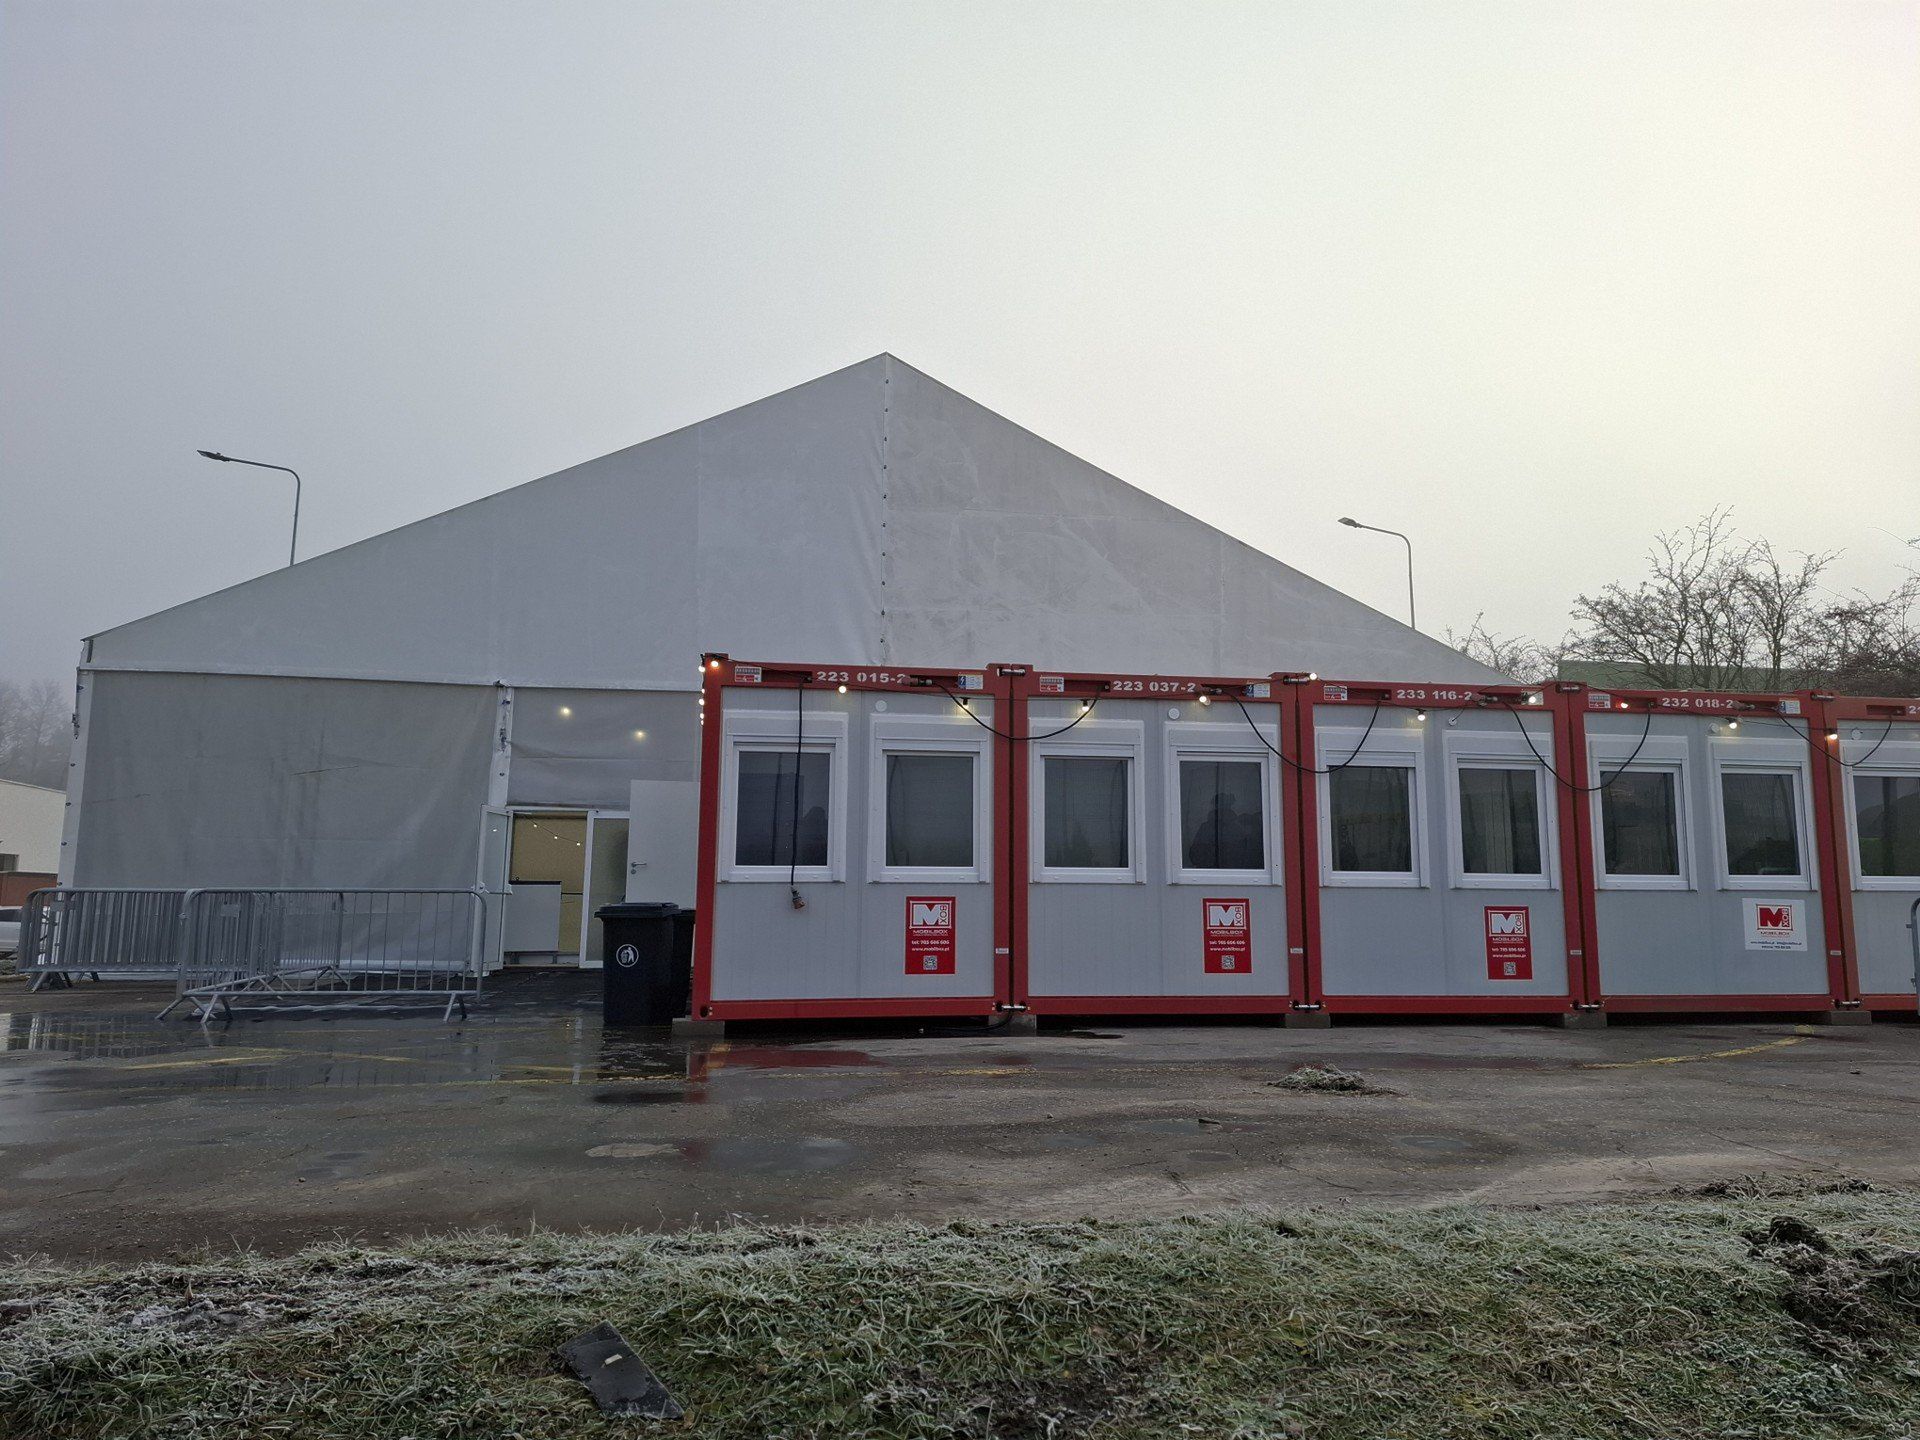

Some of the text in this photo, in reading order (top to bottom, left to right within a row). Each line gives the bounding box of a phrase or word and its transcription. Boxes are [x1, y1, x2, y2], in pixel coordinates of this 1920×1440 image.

[817, 671, 849, 682] 223
[1113, 680, 1197, 692] 223 037-2
[1397, 689, 1472, 701] 233 116-2
[1661, 697, 1734, 708] 232 018-2
[913, 904, 948, 925] M
[1210, 905, 1243, 926] M
[1759, 907, 1790, 927] M
[1491, 913, 1523, 933] M
